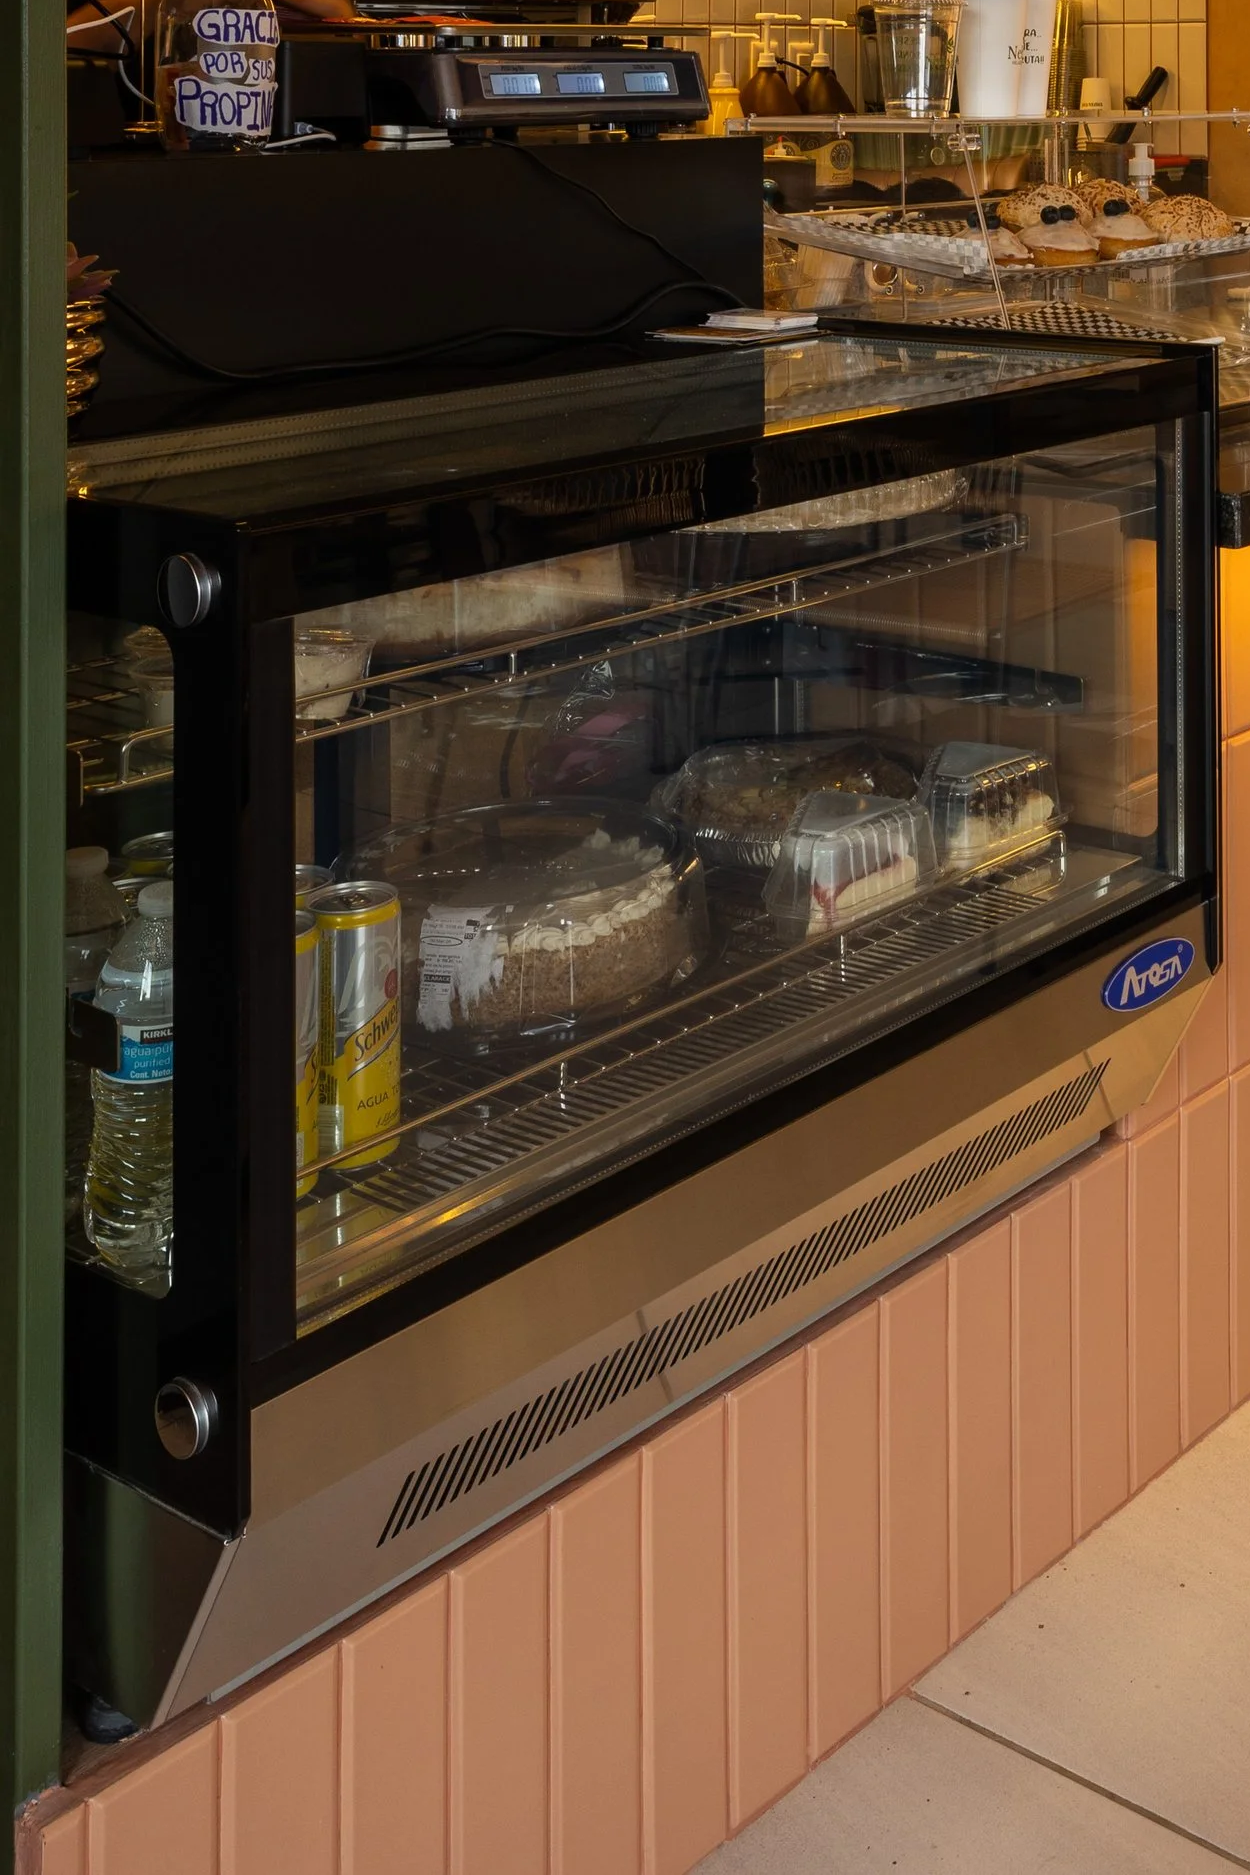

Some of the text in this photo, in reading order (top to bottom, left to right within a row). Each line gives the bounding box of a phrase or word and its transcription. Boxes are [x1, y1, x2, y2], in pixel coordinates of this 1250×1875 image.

[203, 52, 273, 81] POR SUS
[178, 78, 273, 132] PROPIN
[124, 1046, 151, 1059] agua
[134, 1056, 170, 1069] purified
[357, 1091, 389, 1111] AGUA
